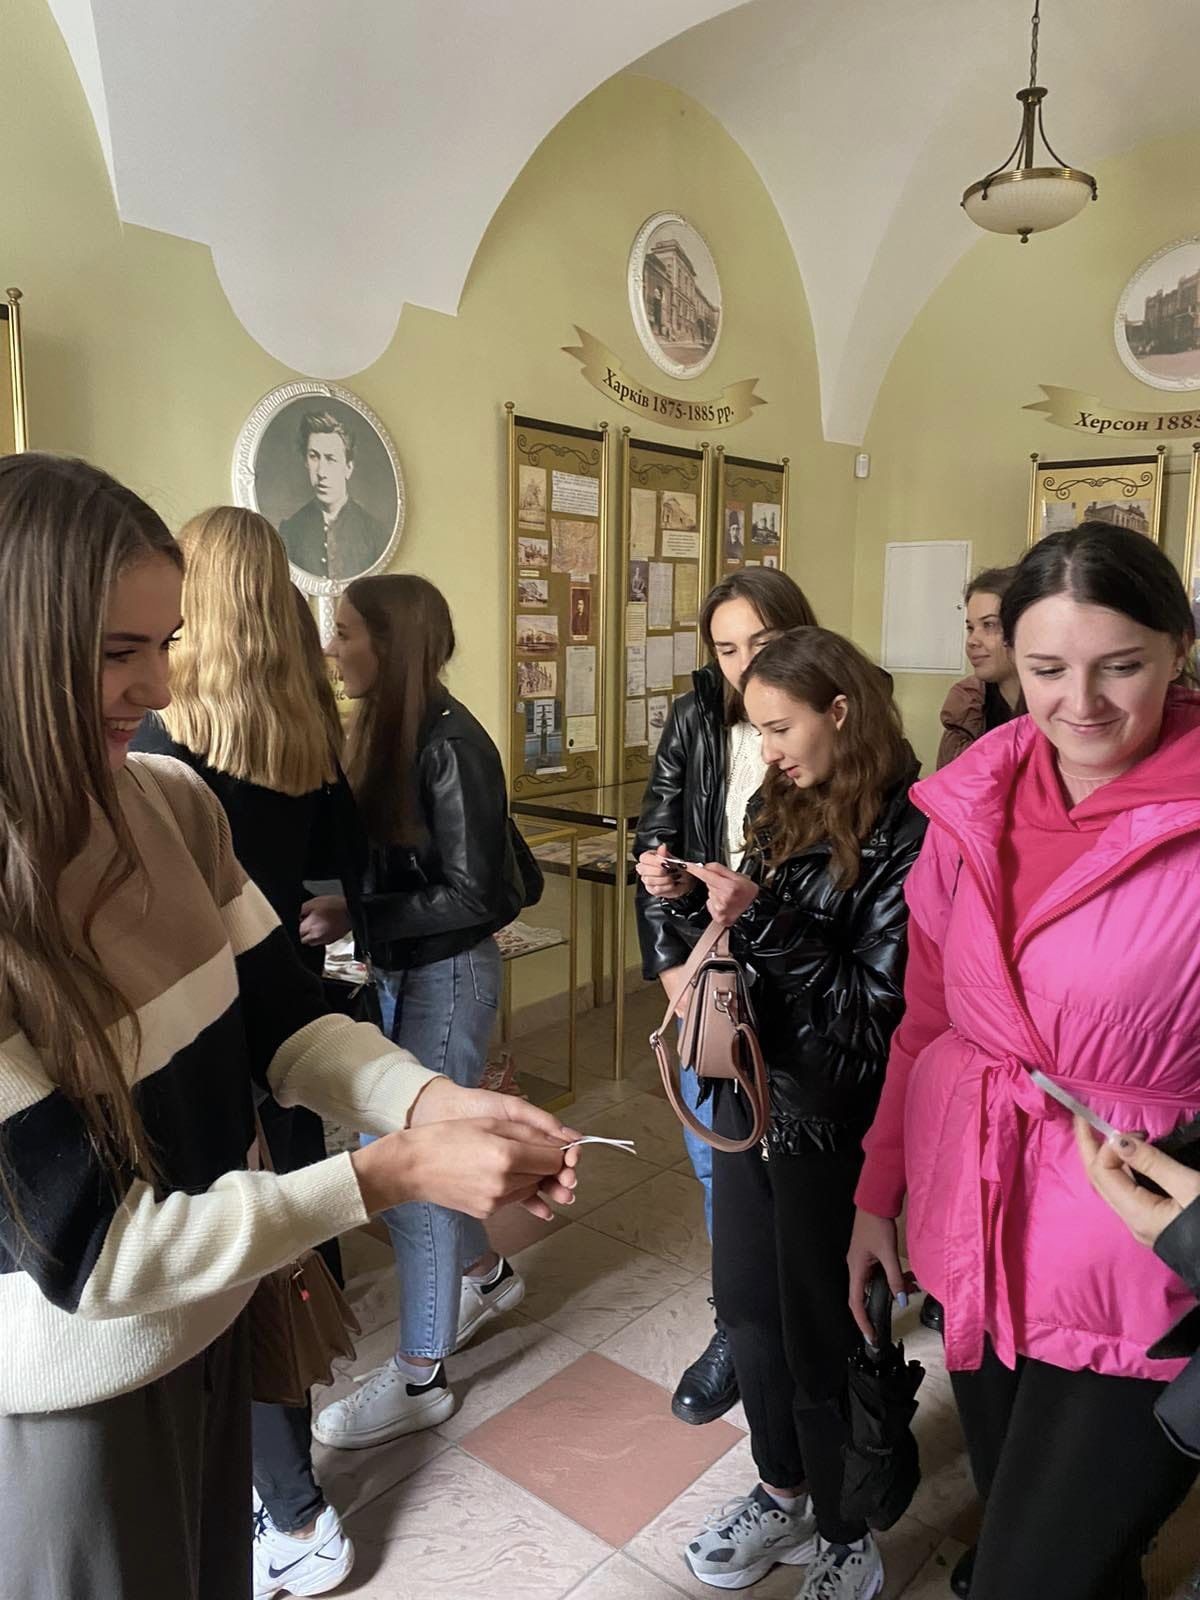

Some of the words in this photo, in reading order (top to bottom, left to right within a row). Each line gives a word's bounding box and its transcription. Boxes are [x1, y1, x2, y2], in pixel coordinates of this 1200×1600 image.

[602, 367, 649, 408] Харків
[653, 396, 715, 421] 1875-1885
[1075, 411, 1150, 434] Херсон
